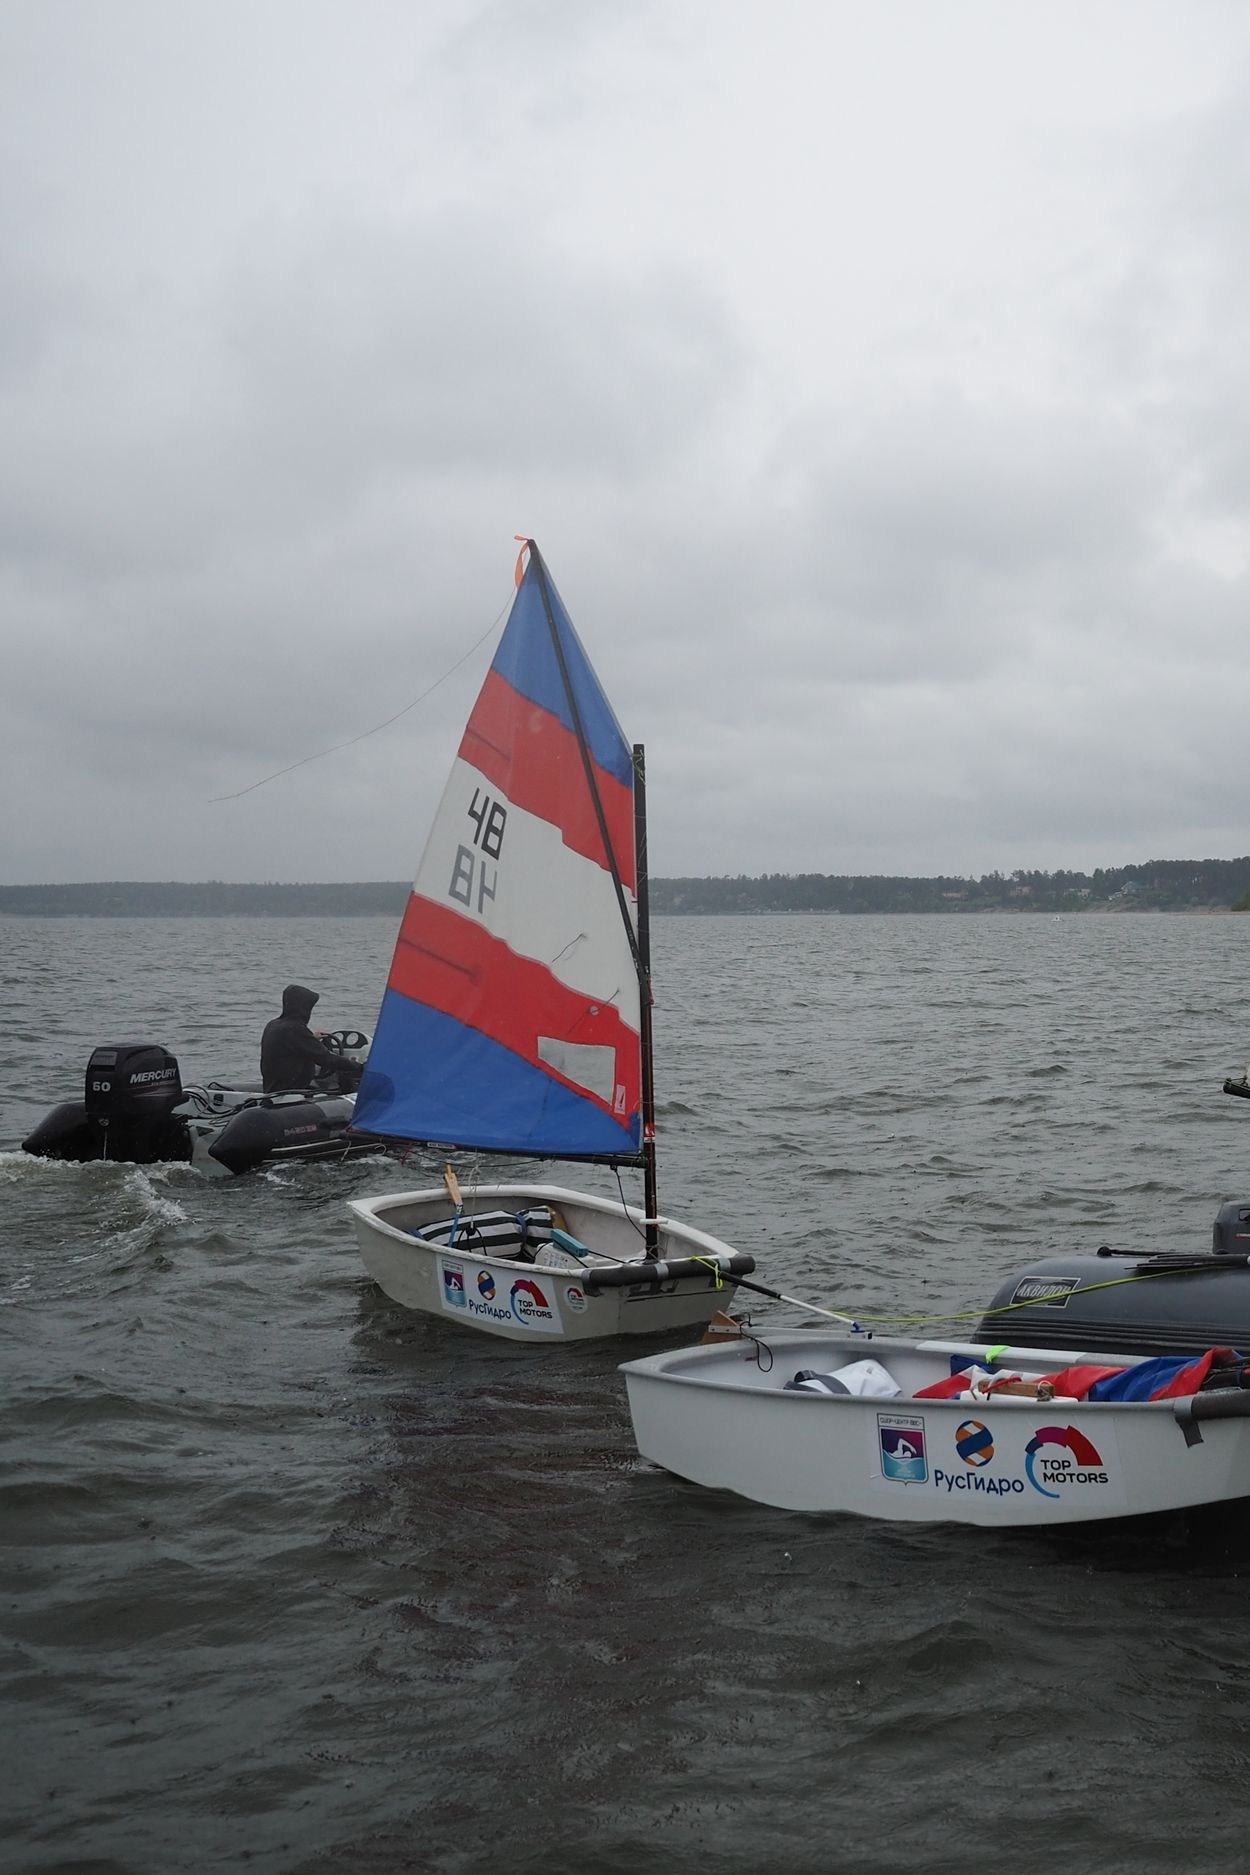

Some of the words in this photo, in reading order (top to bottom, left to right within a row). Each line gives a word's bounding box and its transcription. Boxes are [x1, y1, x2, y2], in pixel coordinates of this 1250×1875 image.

[129, 1067, 177, 1084] MERCURY
[92, 1081, 111, 1092] 60
[468, 1299, 512, 1320] РусГидро
[518, 1299, 534, 1308] TOP
[519, 1307, 553, 1319] MOTORS
[1040, 1458, 1072, 1471] TOP
[934, 1469, 1025, 1496] РусГидро
[1043, 1472, 1109, 1484] MOTORS
